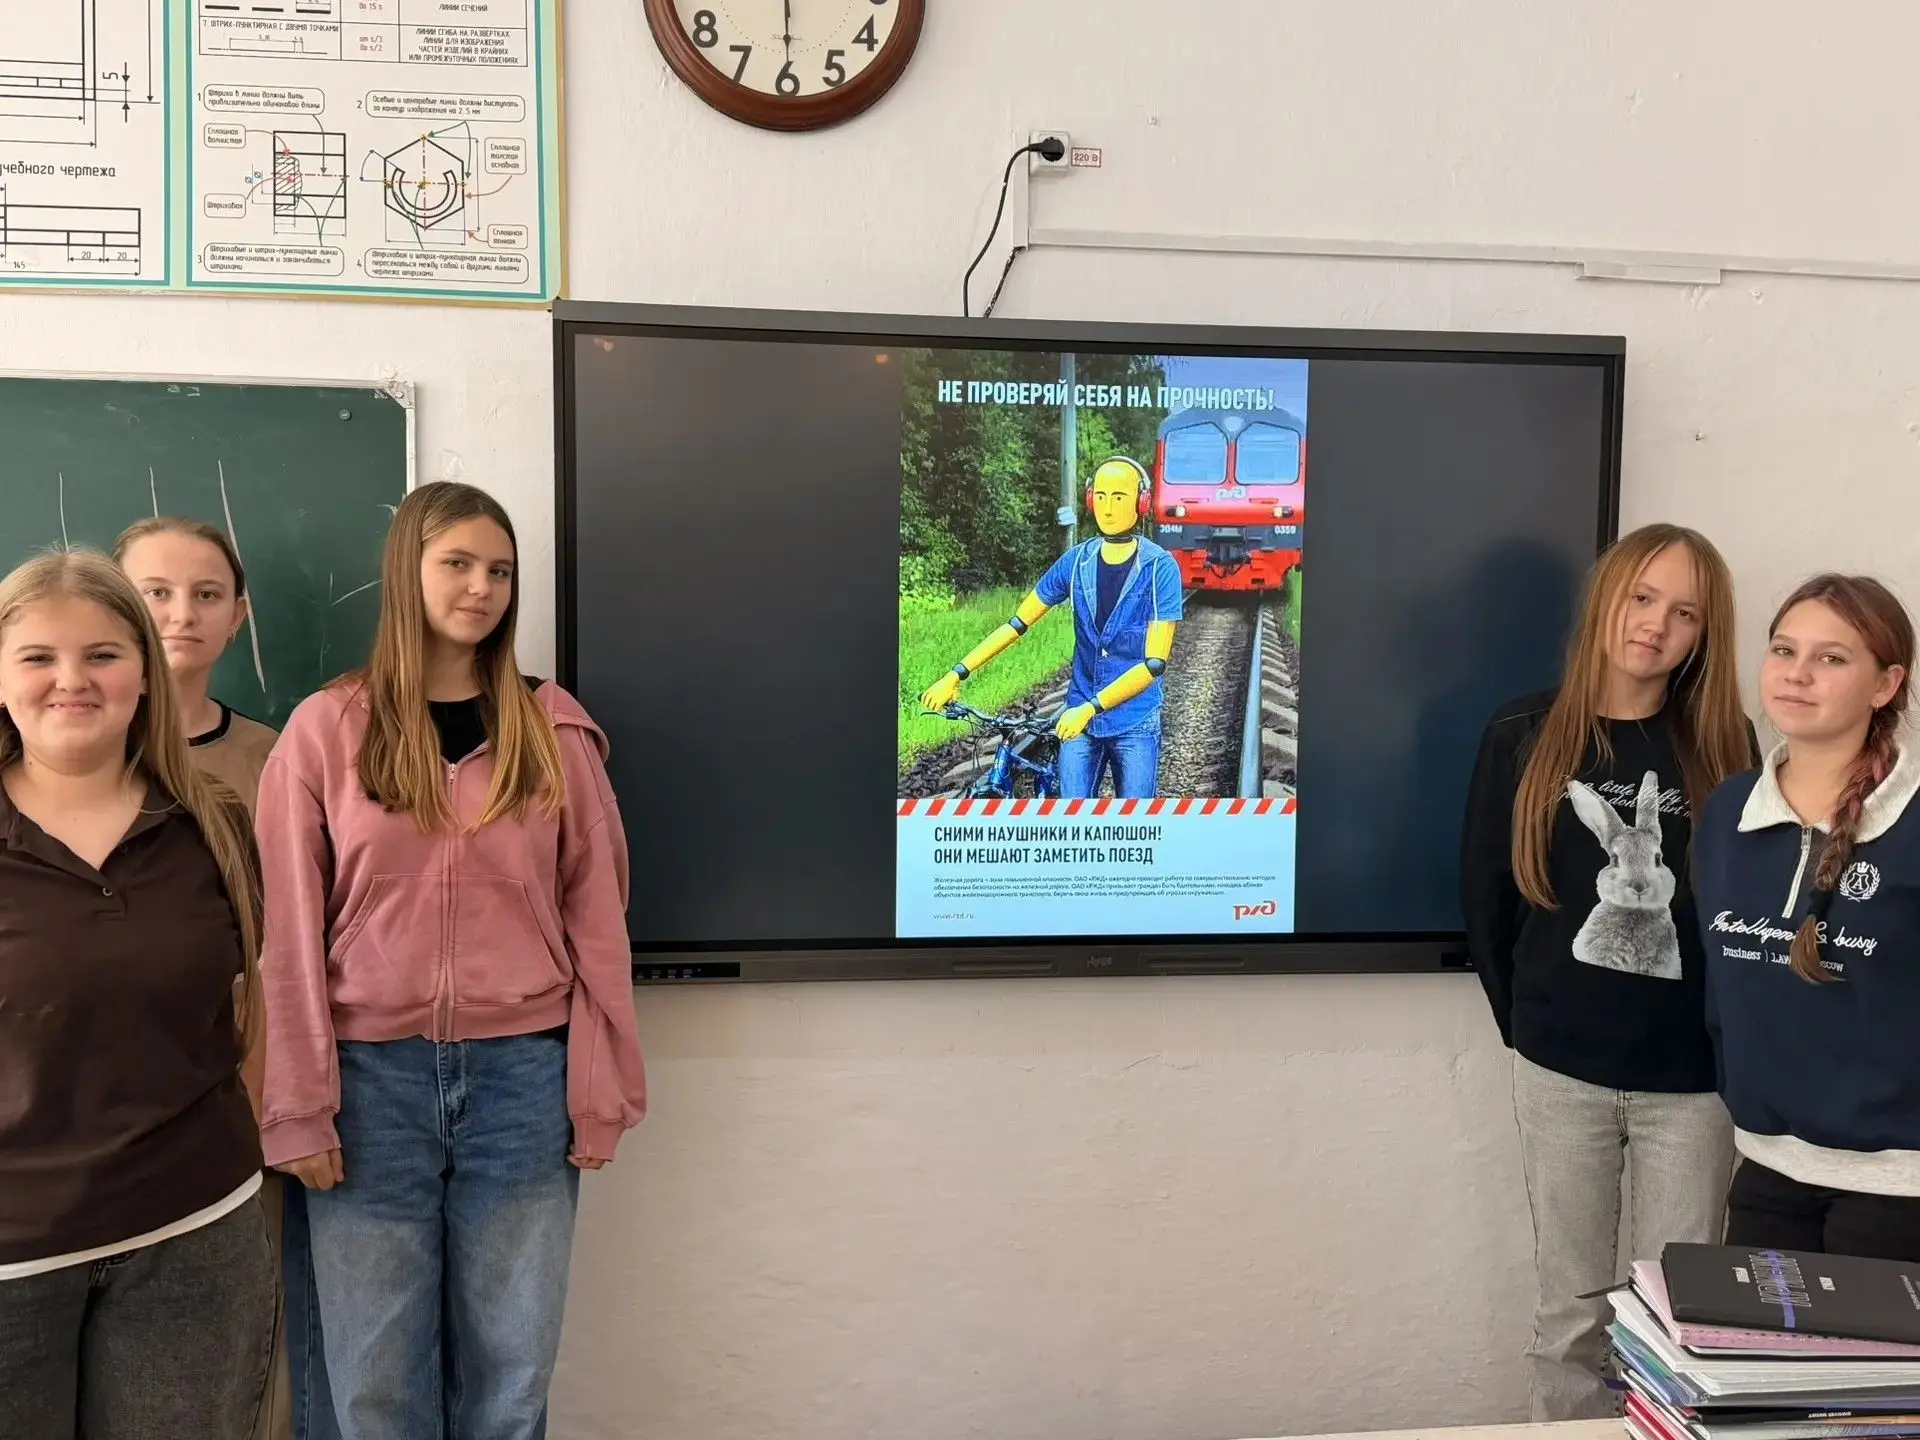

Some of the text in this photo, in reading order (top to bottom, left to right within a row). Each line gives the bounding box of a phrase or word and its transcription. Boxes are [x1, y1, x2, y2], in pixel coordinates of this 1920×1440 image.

[310, 24, 339, 32] ТОЧКАМИ
[692, 10, 718, 48] 8
[851, 14, 878, 52] 4
[423, 55, 476, 63] ПРОМЕЖУТОЧНЫХ
[730, 45, 752, 84] 7
[102, 72, 118, 80] 5
[822, 50, 846, 86] 5
[775, 61, 800, 96] 6
[357, 100, 362, 109] 2
[1074, 153, 1089, 161] 220
[60, 165, 116, 179] чертежа
[938, 378, 1274, 411] НЕ ПРОВЕРЯЙ СЕБЯ НА ПРОЧНОСТЬ!
[934, 826, 1162, 842] СНИМИ НАУШНИКИ И КАПЮШОН!
[934, 847, 1154, 865] ОНИ МЕШАЮТ ЗАМЕТИТЬ ПОЕЗД
[1852, 873, 1863, 890] A
[1833, 926, 1878, 956] busy
[1722, 945, 1761, 960] business
